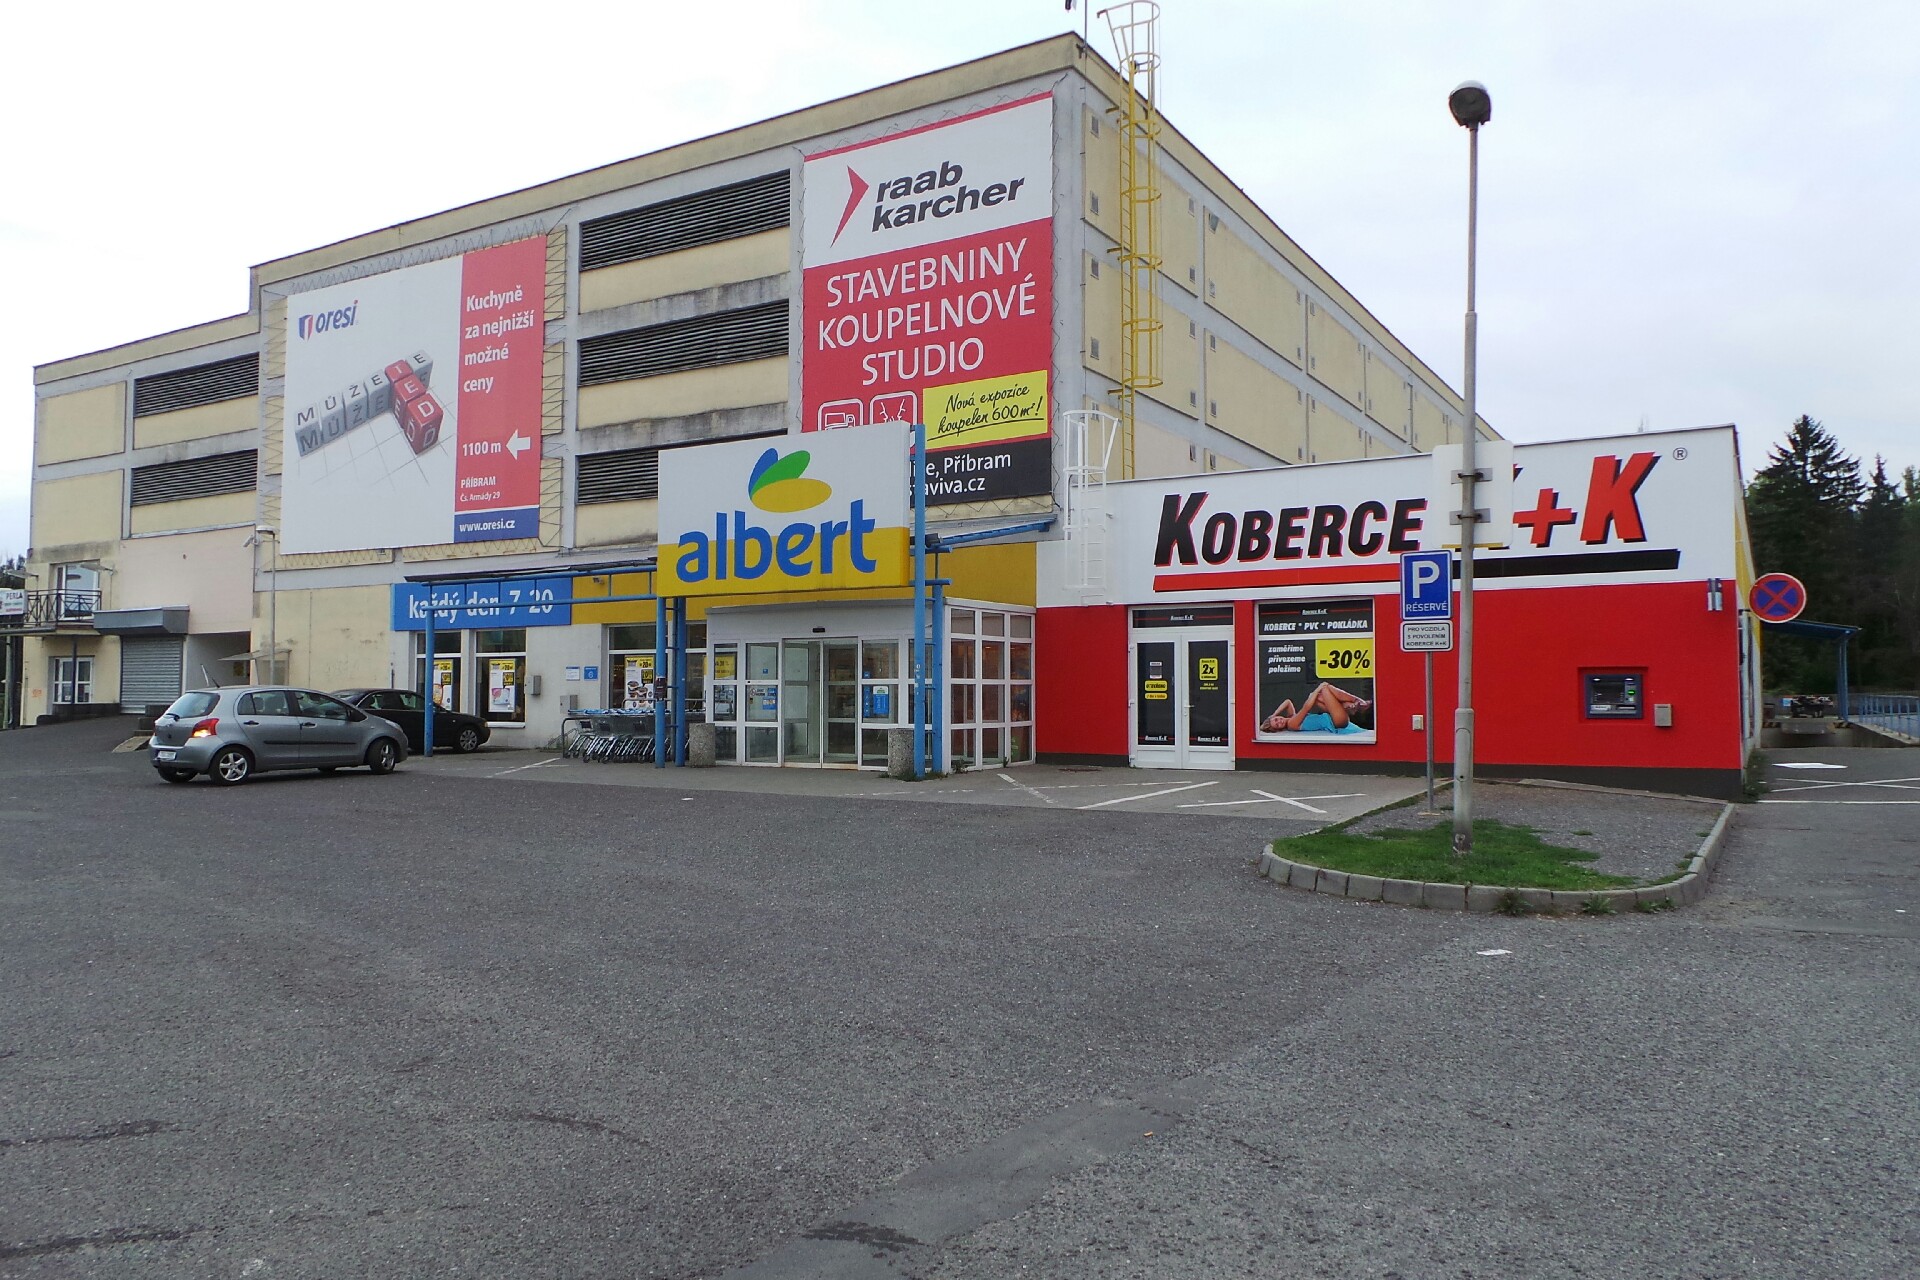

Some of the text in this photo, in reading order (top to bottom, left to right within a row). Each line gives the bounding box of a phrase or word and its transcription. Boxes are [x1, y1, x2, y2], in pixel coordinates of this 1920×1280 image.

[876, 160, 963, 203] raab
[872, 177, 1025, 232] karcher
[827, 237, 1027, 308] STAVEBNINY
[466, 285, 523, 312] Kuchyně
[818, 273, 1036, 350] KOUPELNOVÉ
[315, 300, 358, 333] oresi
[464, 310, 535, 339] za nejnižší
[464, 343, 510, 366] možné
[862, 337, 984, 386] STUDIO
[463, 376, 494, 394] ceny
[945, 384, 1030, 414] Nová expozice
[937, 408, 989, 437] koupelen
[462, 441, 501, 456] 1100 m
[943, 454, 1012, 474] Příbram
[460, 476, 496, 488] PŘÍBRAM
[469, 491, 493, 502] Armády
[493, 491, 501, 499] 29
[1455, 452, 1662, 549] +K
[459, 518, 516, 532] www.oresi.cz
[1153, 491, 1428, 568] KOBERCE
[676, 498, 877, 583] albert
[1412, 560, 1440, 599] P
[409, 591, 460, 624] každý
[467, 591, 499, 617] den
[1406, 600, 1448, 612] RÉSERVÉ
[1264, 618, 1368, 631] KOBERCE PVC POKLÁDKA
[1319, 649, 1371, 669] -30%
